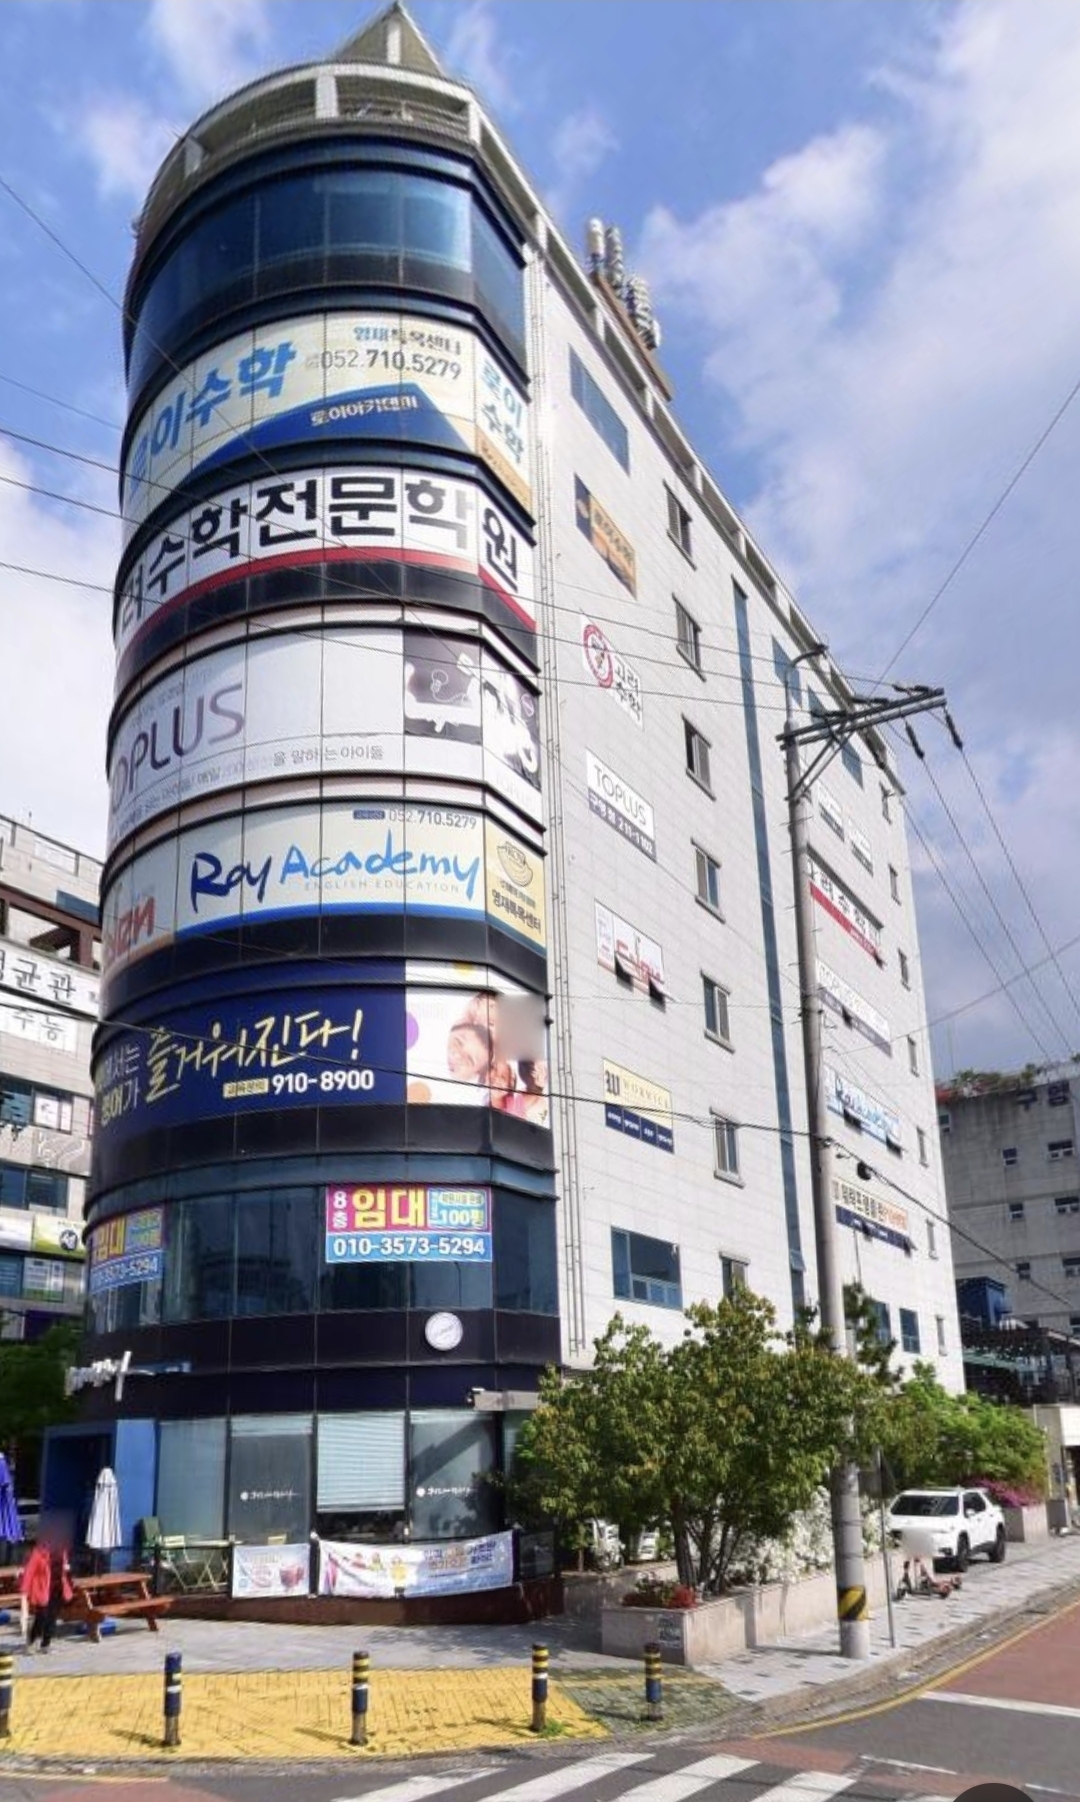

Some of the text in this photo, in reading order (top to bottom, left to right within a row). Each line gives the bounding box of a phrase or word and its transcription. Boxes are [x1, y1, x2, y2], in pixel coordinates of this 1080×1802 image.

[320, 347, 462, 380] 052.710.5279
[340, 744, 385, 762] 아이들
[593, 764, 647, 827] TOPLUS
[389, 809, 477, 830] 052.710.5279
[279, 827, 481, 901] Academy
[304, 879, 460, 894] ENGLISH EDUCATION
[272, 1069, 375, 1096] 910-8900
[332, 1190, 349, 1229] 8층
[351, 1187, 425, 1228] 임대
[332, 1236, 486, 1256] 010-3573-5294
